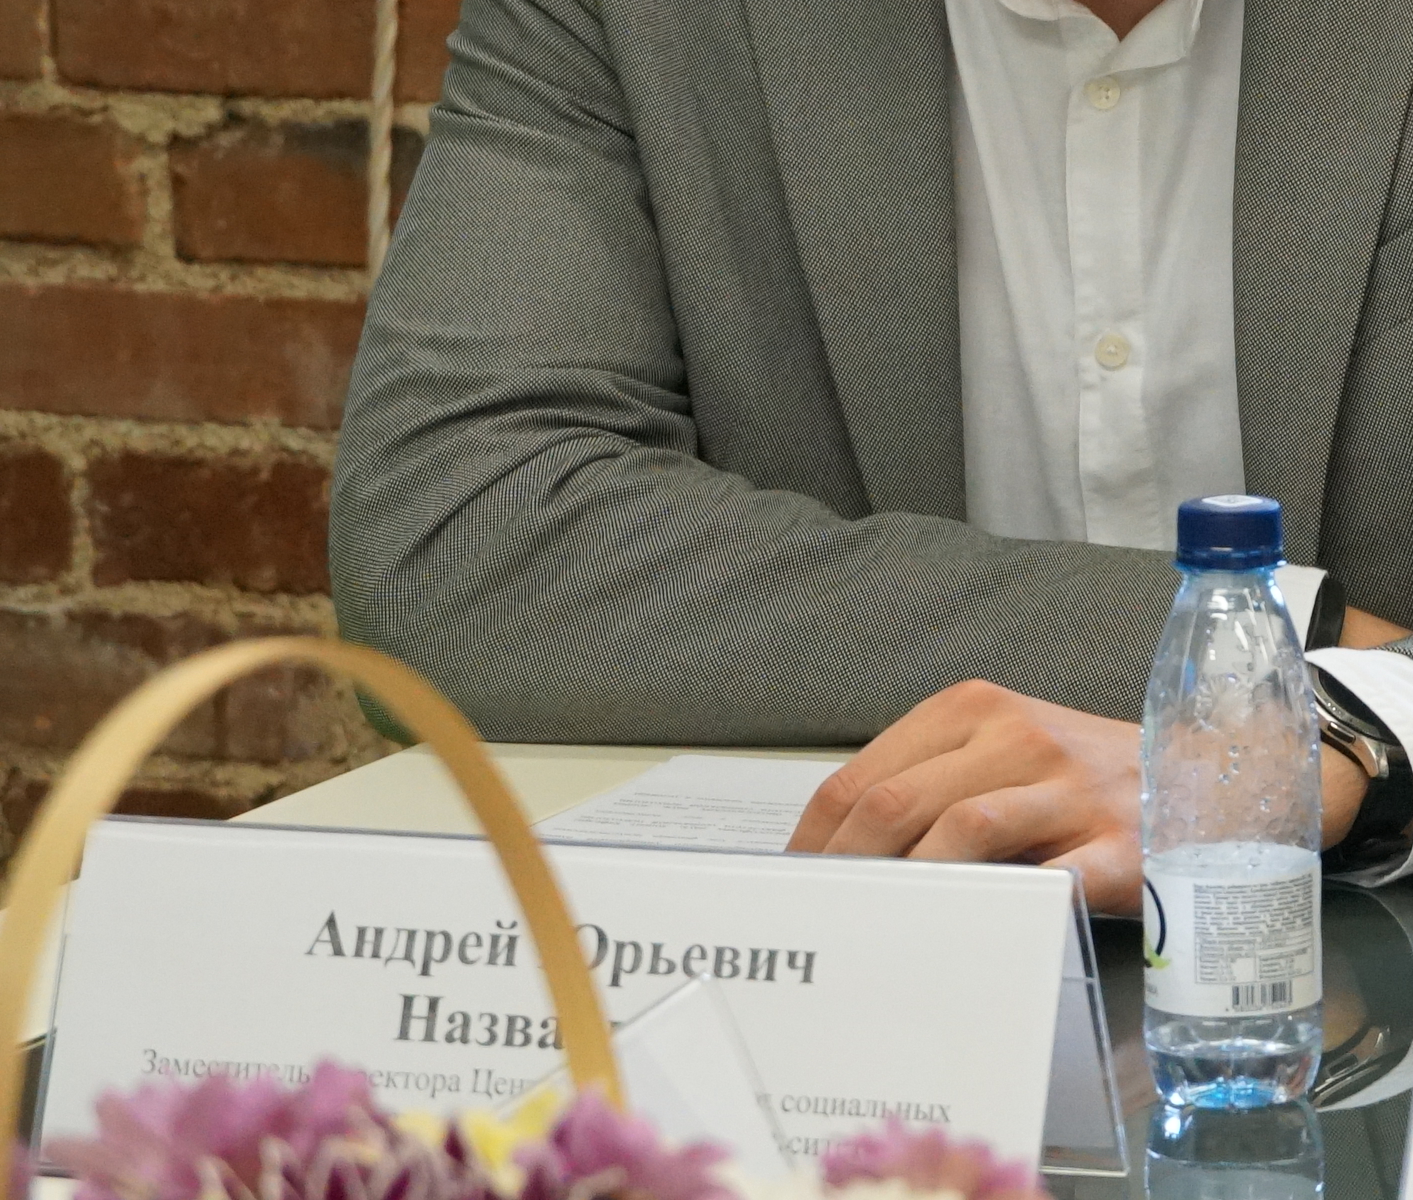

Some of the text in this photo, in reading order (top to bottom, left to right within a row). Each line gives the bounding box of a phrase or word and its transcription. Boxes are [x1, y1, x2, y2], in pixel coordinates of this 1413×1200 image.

[304, 910, 522, 977] Андрей
[394, 993, 624, 1051] Назва
[779, 1093, 952, 1124] социальных
